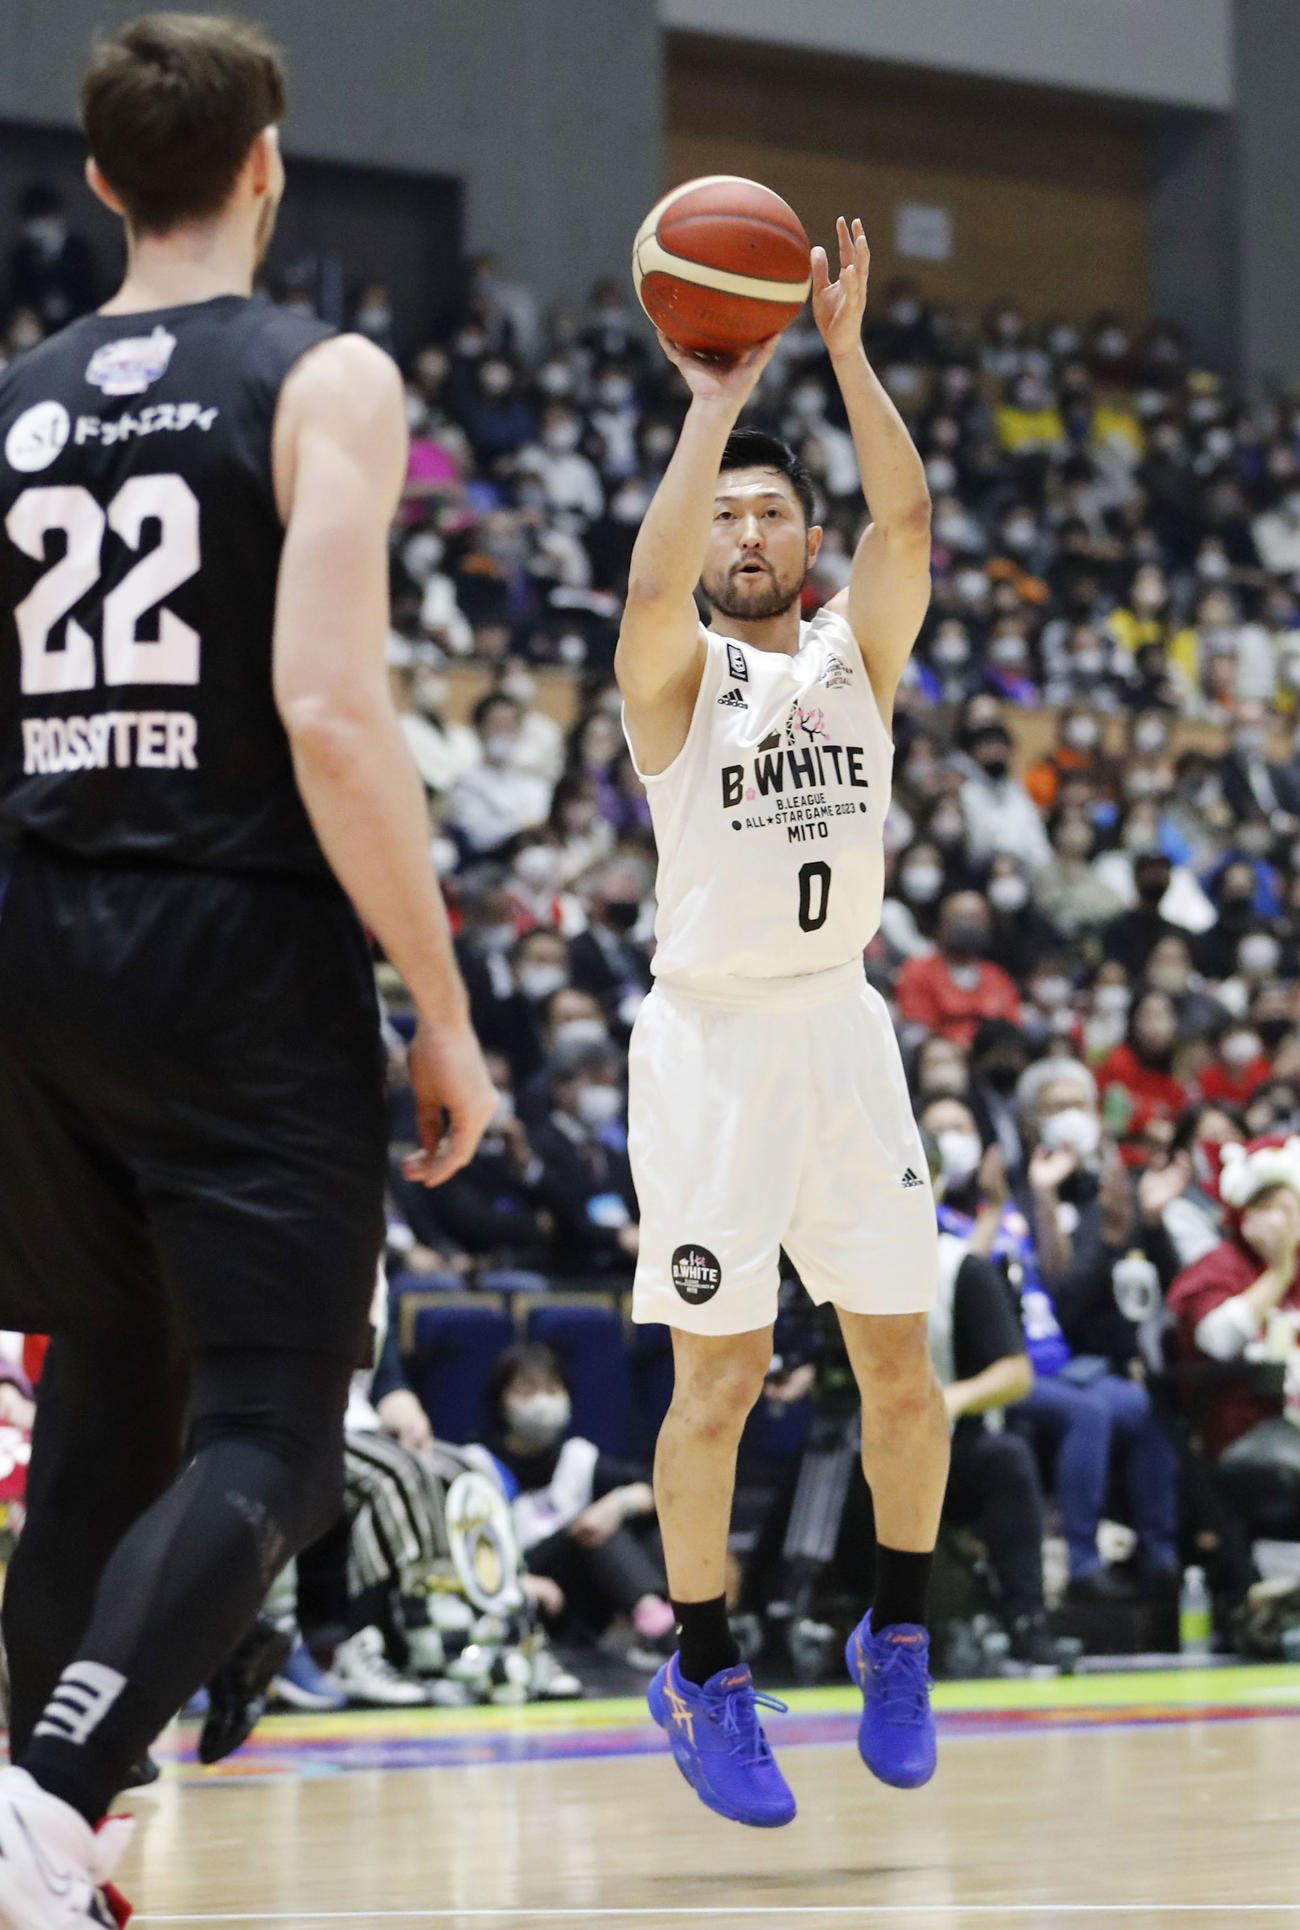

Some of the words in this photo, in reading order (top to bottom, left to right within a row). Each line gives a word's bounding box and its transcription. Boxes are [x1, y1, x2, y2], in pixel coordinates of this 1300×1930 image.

[74, 402, 219, 445] ドットエスティ
[5, 472, 201, 695] 22
[717, 698, 748, 710] adidas
[776, 793, 826, 810] B.LEAGUE
[806, 805, 834, 820] GAME
[835, 803, 856, 815] 2023
[787, 822, 828, 843] MITO
[798, 860, 832, 933] 0
